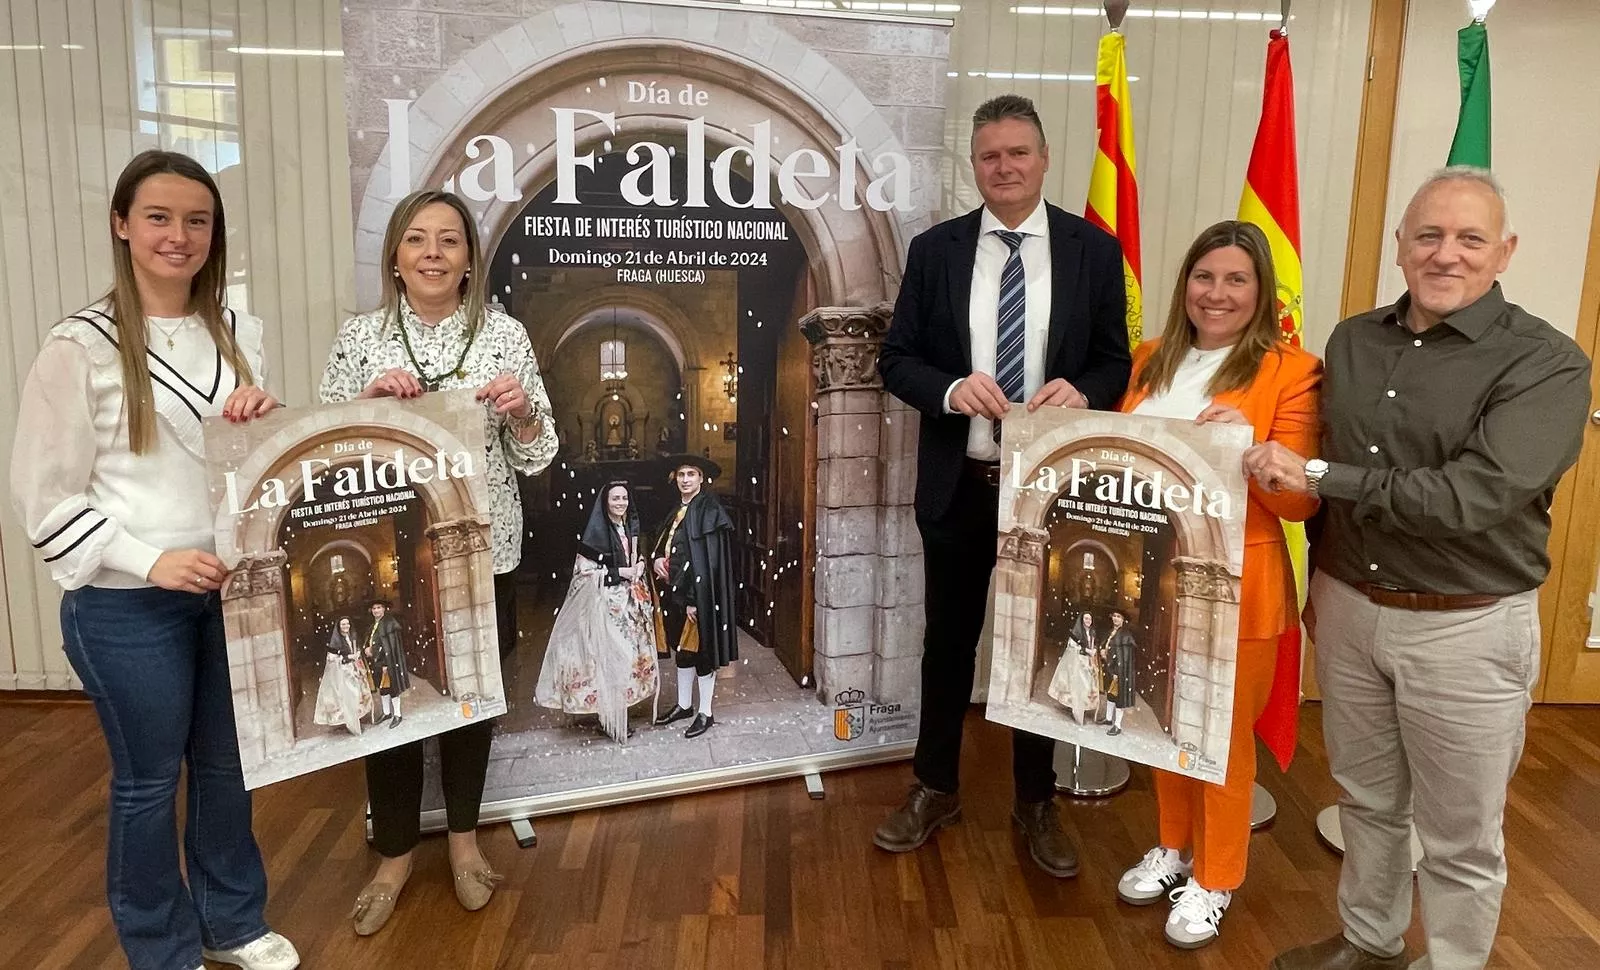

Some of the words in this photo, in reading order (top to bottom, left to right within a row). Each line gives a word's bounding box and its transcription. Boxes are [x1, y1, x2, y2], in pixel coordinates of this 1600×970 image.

[628, 80, 674, 105] Día
[678, 83, 709, 107] de
[381, 98, 523, 203] La
[549, 106, 917, 212] Faldeta
[524, 216, 571, 237] FIESTA
[575, 217, 592, 237] DE
[596, 213, 651, 239] INTERÉS
[654, 214, 723, 240] TURÍSTICO
[727, 220, 789, 241] NACIONAL
[549, 248, 622, 268] Domingo
[625, 250, 641, 265] 21
[643, 250, 663, 265] de
[666, 250, 706, 266] Abril
[708, 251, 728, 266] de
[730, 252, 768, 266] 2024
[617, 268, 652, 283] FRAGA
[655, 269, 706, 285] (HUESCA)
[334, 442, 355, 454] Día
[357, 440, 374, 451] de
[1101, 450, 1120, 463] Día
[1122, 452, 1136, 464] de
[223, 470, 291, 516] La
[299, 447, 477, 503] Faldeta
[1011, 451, 1059, 494] La
[1069, 457, 1234, 520] Faldeta
[291, 506, 314, 518] FIESTA
[314, 505, 323, 514] DE
[324, 498, 351, 512] INTERÉS
[352, 495, 385, 508] TURÍSTICO
[385, 490, 417, 503] NACIONAL
[303, 517, 338, 528] Domingo
[338, 514, 347, 522] 21
[347, 512, 358, 521] de
[358, 509, 378, 520] Abril
[378, 507, 388, 516] de
[388, 504, 407, 514] 2024
[1140, 524, 1158, 534] 2024
[870, 703, 901, 715] Fraga
